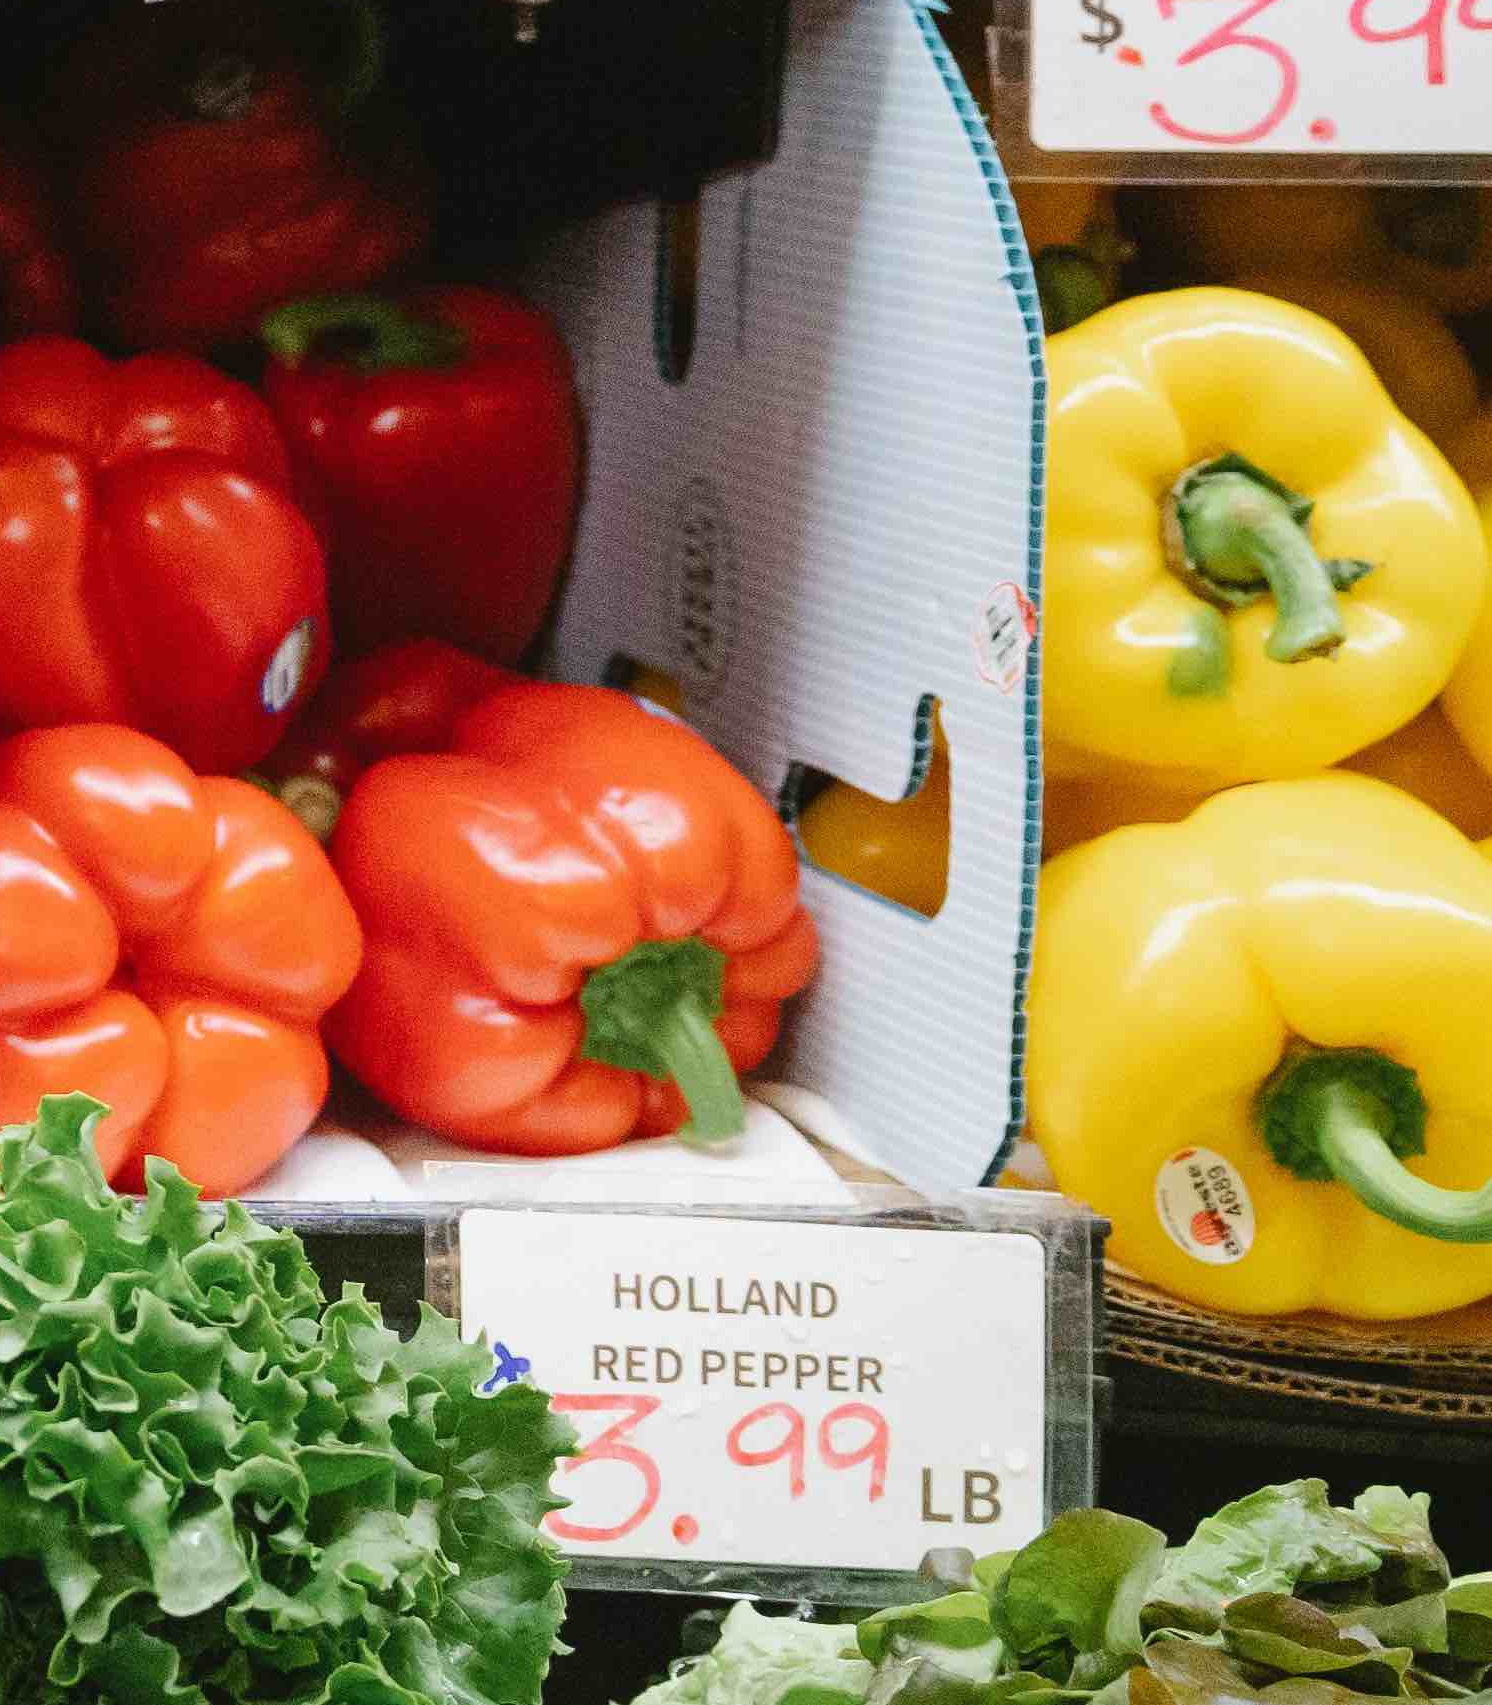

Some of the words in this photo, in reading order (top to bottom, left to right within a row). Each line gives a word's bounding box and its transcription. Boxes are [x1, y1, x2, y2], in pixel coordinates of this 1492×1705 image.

[612, 1271, 839, 1319] HOLLAND
[591, 1343, 684, 1384] RED
[699, 1348, 884, 1394] PEPPER
[920, 1467, 1002, 1526] LB
